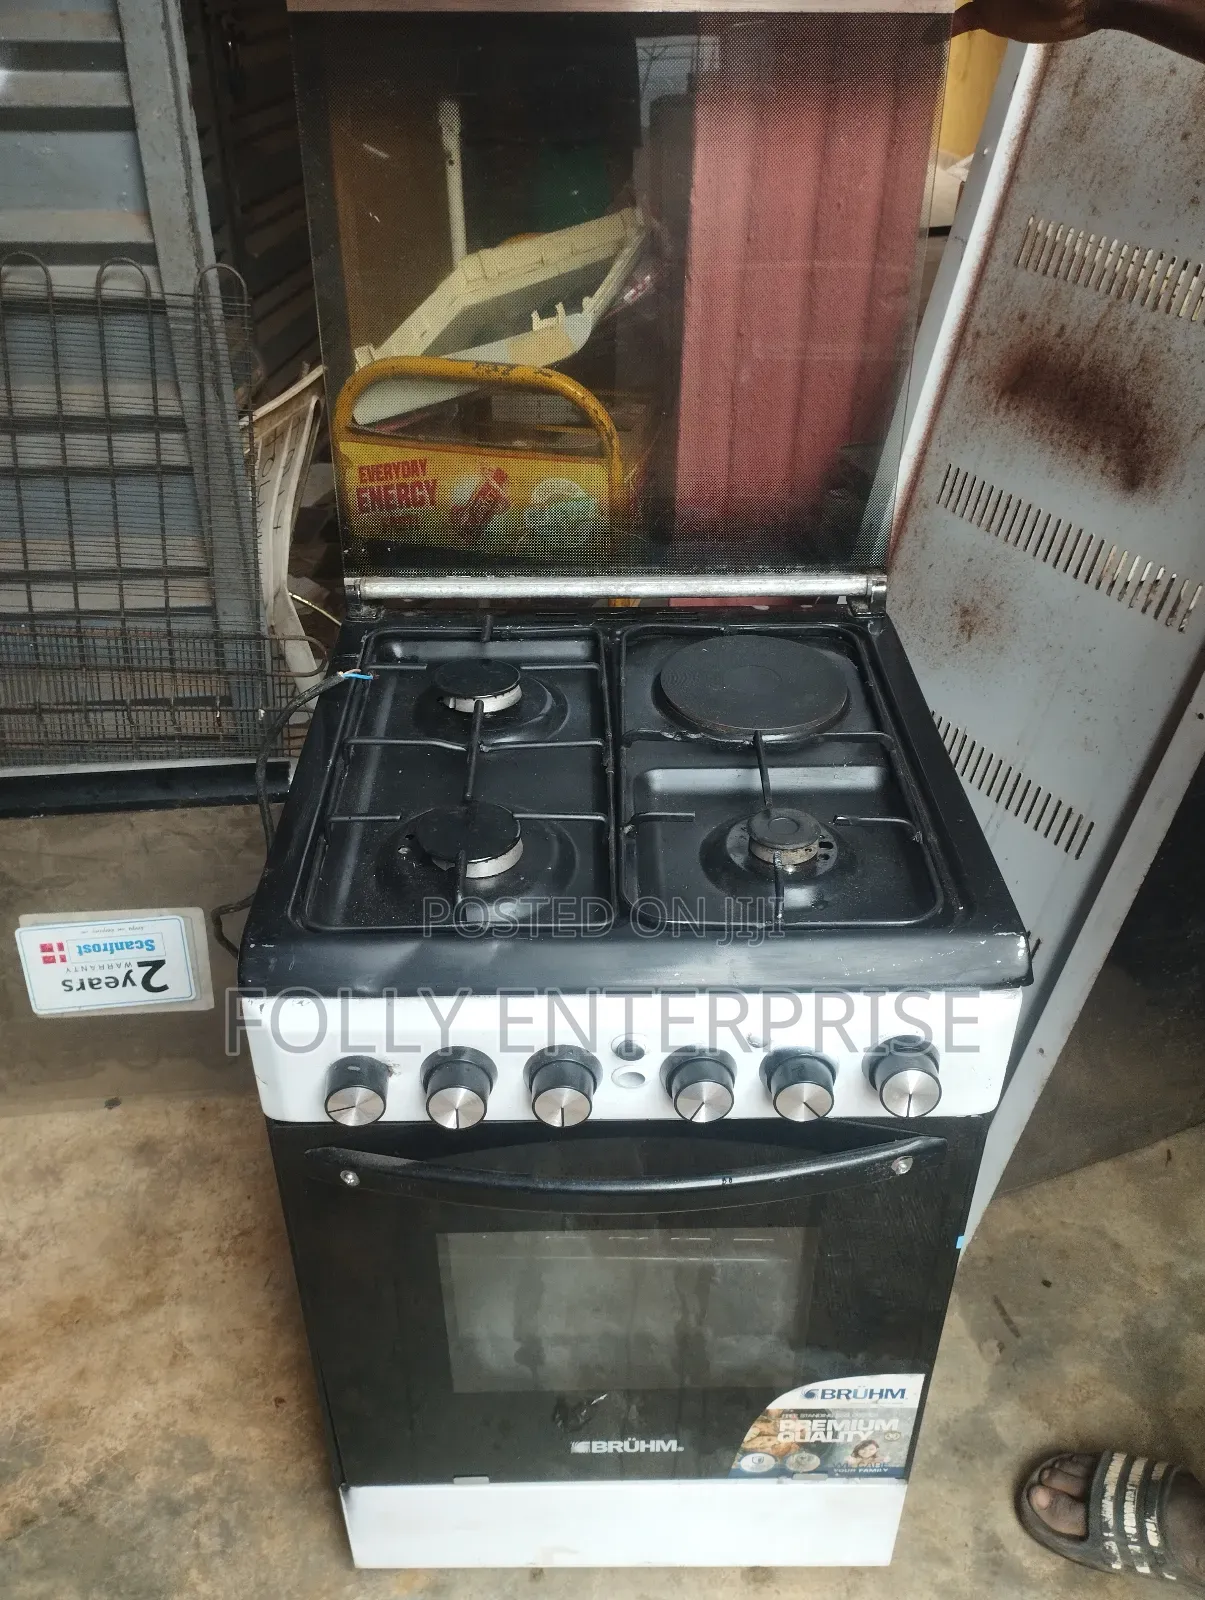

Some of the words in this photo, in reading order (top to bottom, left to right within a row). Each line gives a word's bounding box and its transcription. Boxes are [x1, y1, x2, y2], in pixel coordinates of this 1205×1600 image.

[358, 458, 428, 484] EVERYDAY
[355, 478, 438, 514] ENERGY
[76, 939, 156, 956] Scanfrost
[65, 961, 133, 974] WARRANTY
[136, 959, 170, 993] 2
[62, 969, 137, 993] years
[820, 1385, 906, 1400] BRÜHM
[779, 1418, 899, 1432] PREMIUM
[776, 1430, 874, 1443] QUALITY
